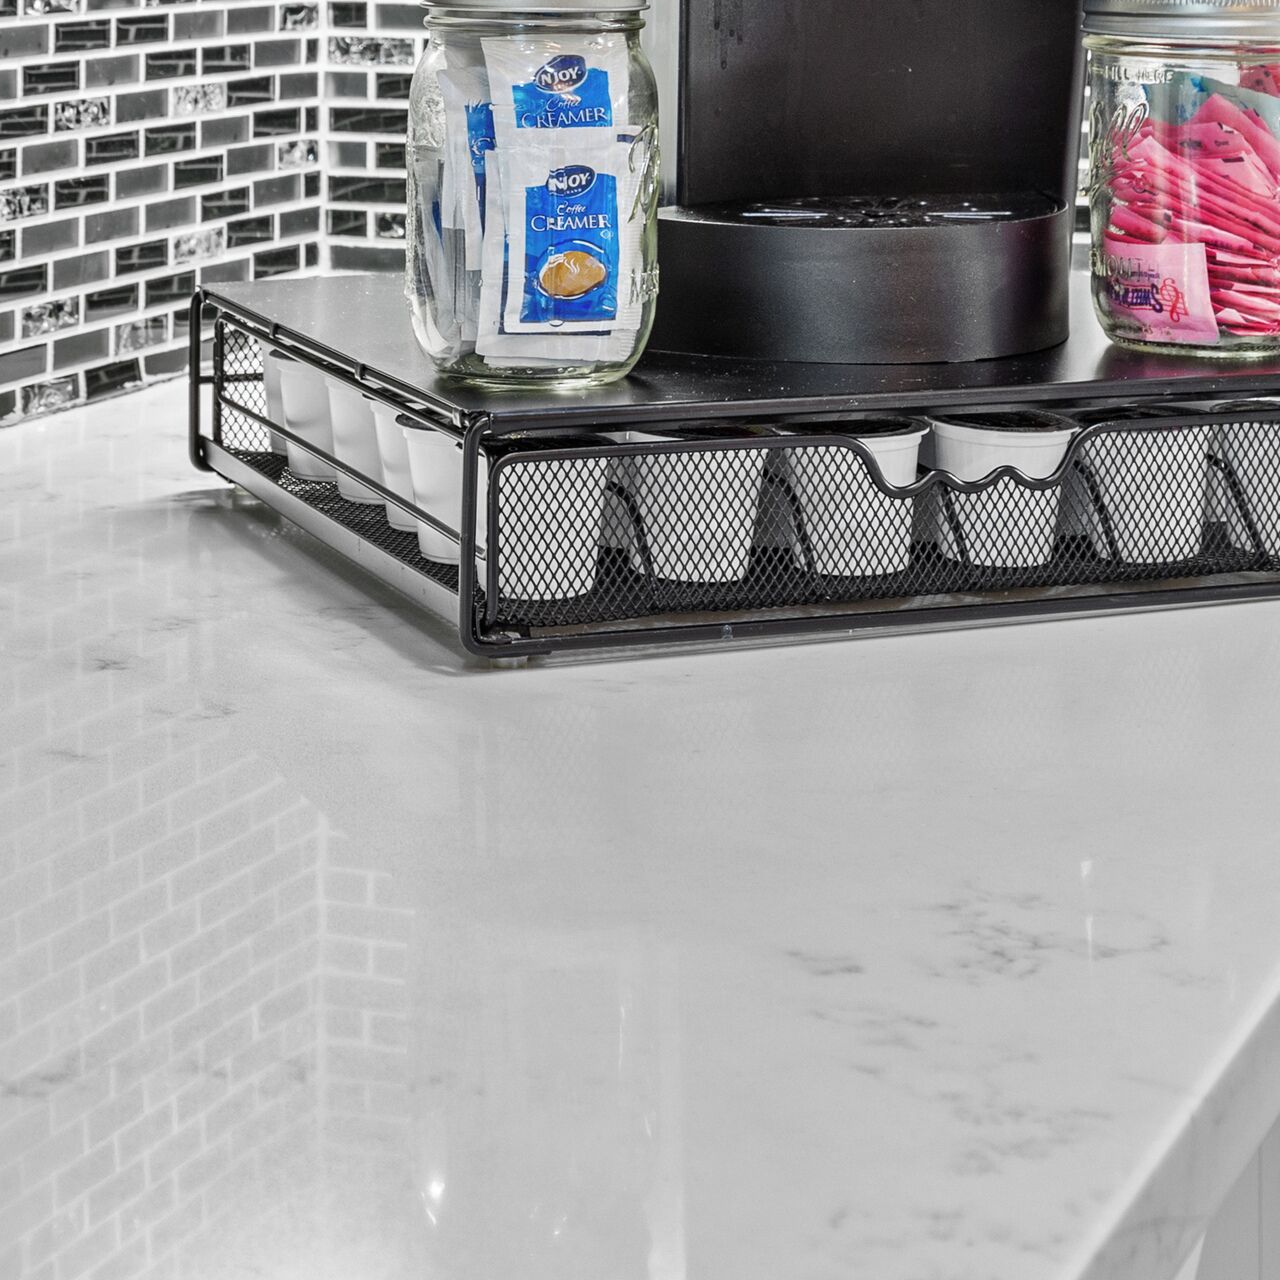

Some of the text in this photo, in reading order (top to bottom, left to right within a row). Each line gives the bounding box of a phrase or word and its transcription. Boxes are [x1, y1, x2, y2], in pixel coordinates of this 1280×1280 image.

[521, 107, 608, 128] CREAMER
[556, 200, 587, 216] Coffee
[530, 214, 612, 232] CREAMER
